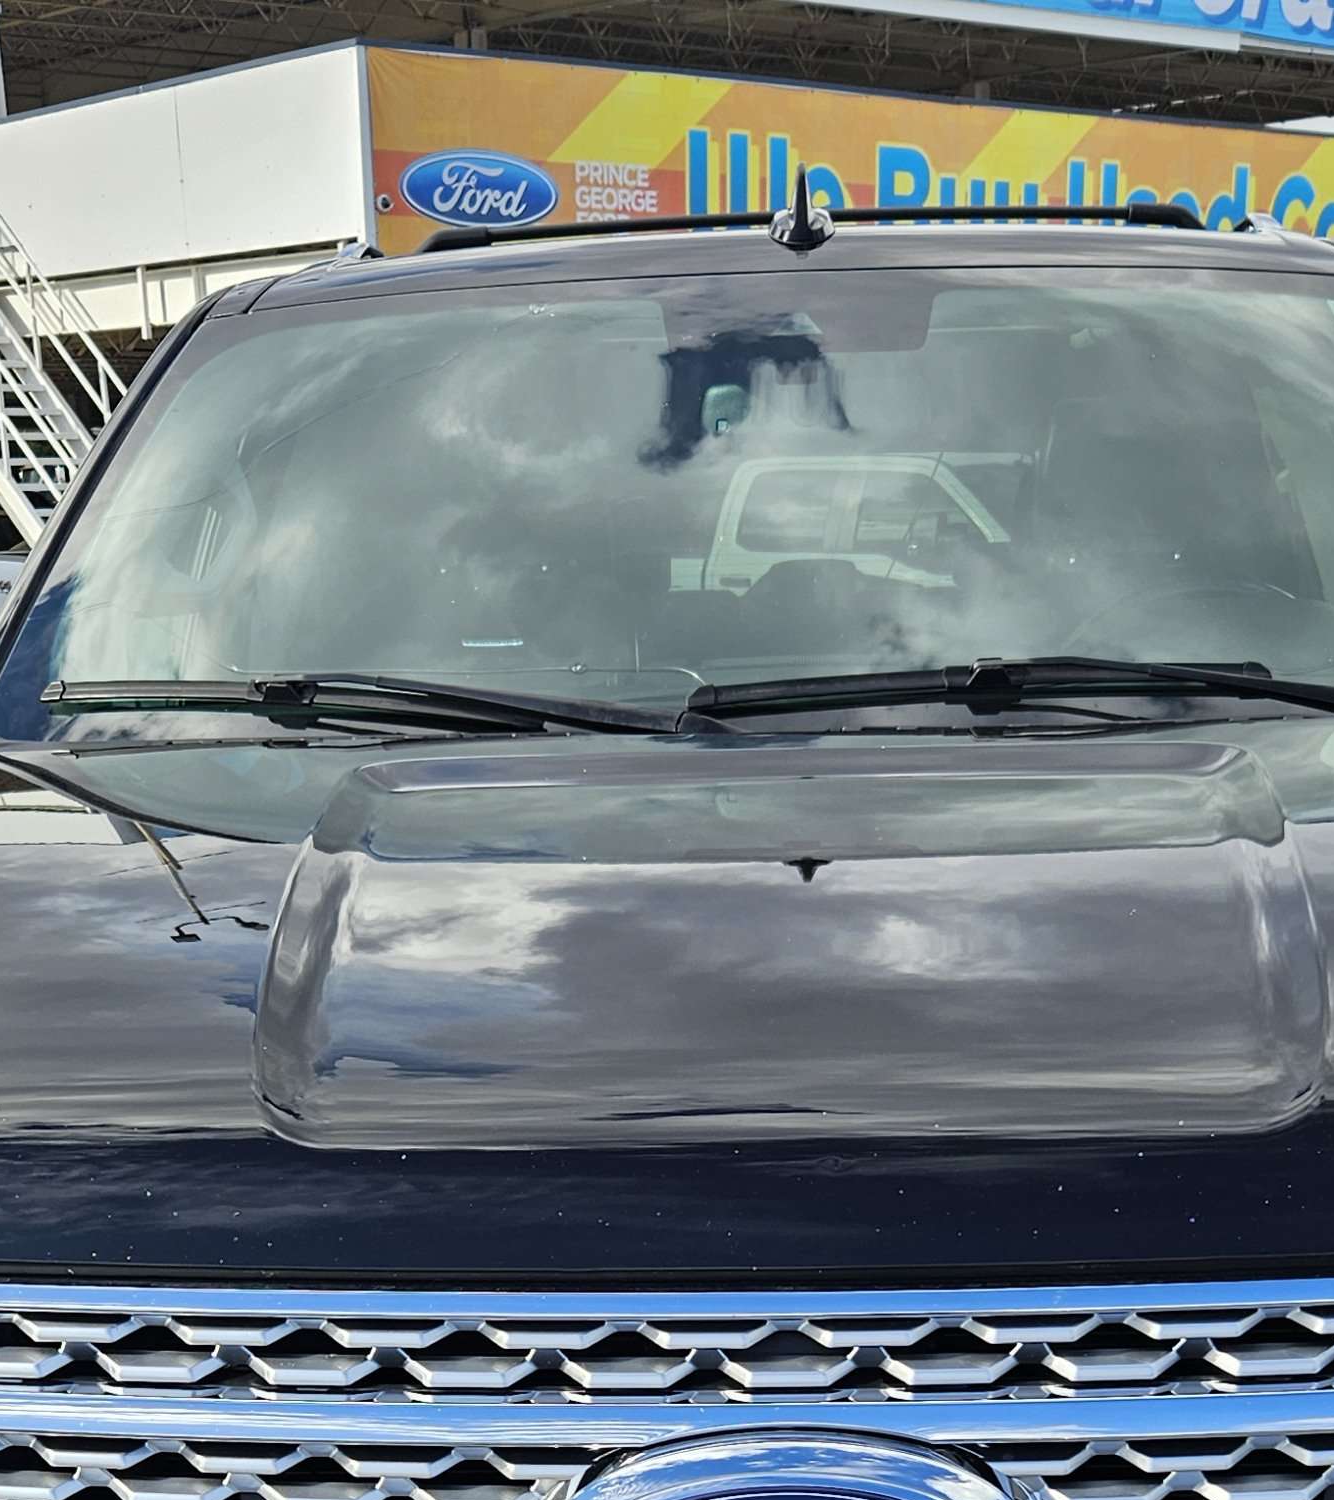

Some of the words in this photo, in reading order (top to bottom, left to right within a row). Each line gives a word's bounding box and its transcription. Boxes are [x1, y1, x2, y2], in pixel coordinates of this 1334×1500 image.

[574, 160, 650, 187] PRINCE
[432, 160, 529, 219] Ford
[574, 185, 659, 213] GEORGE
